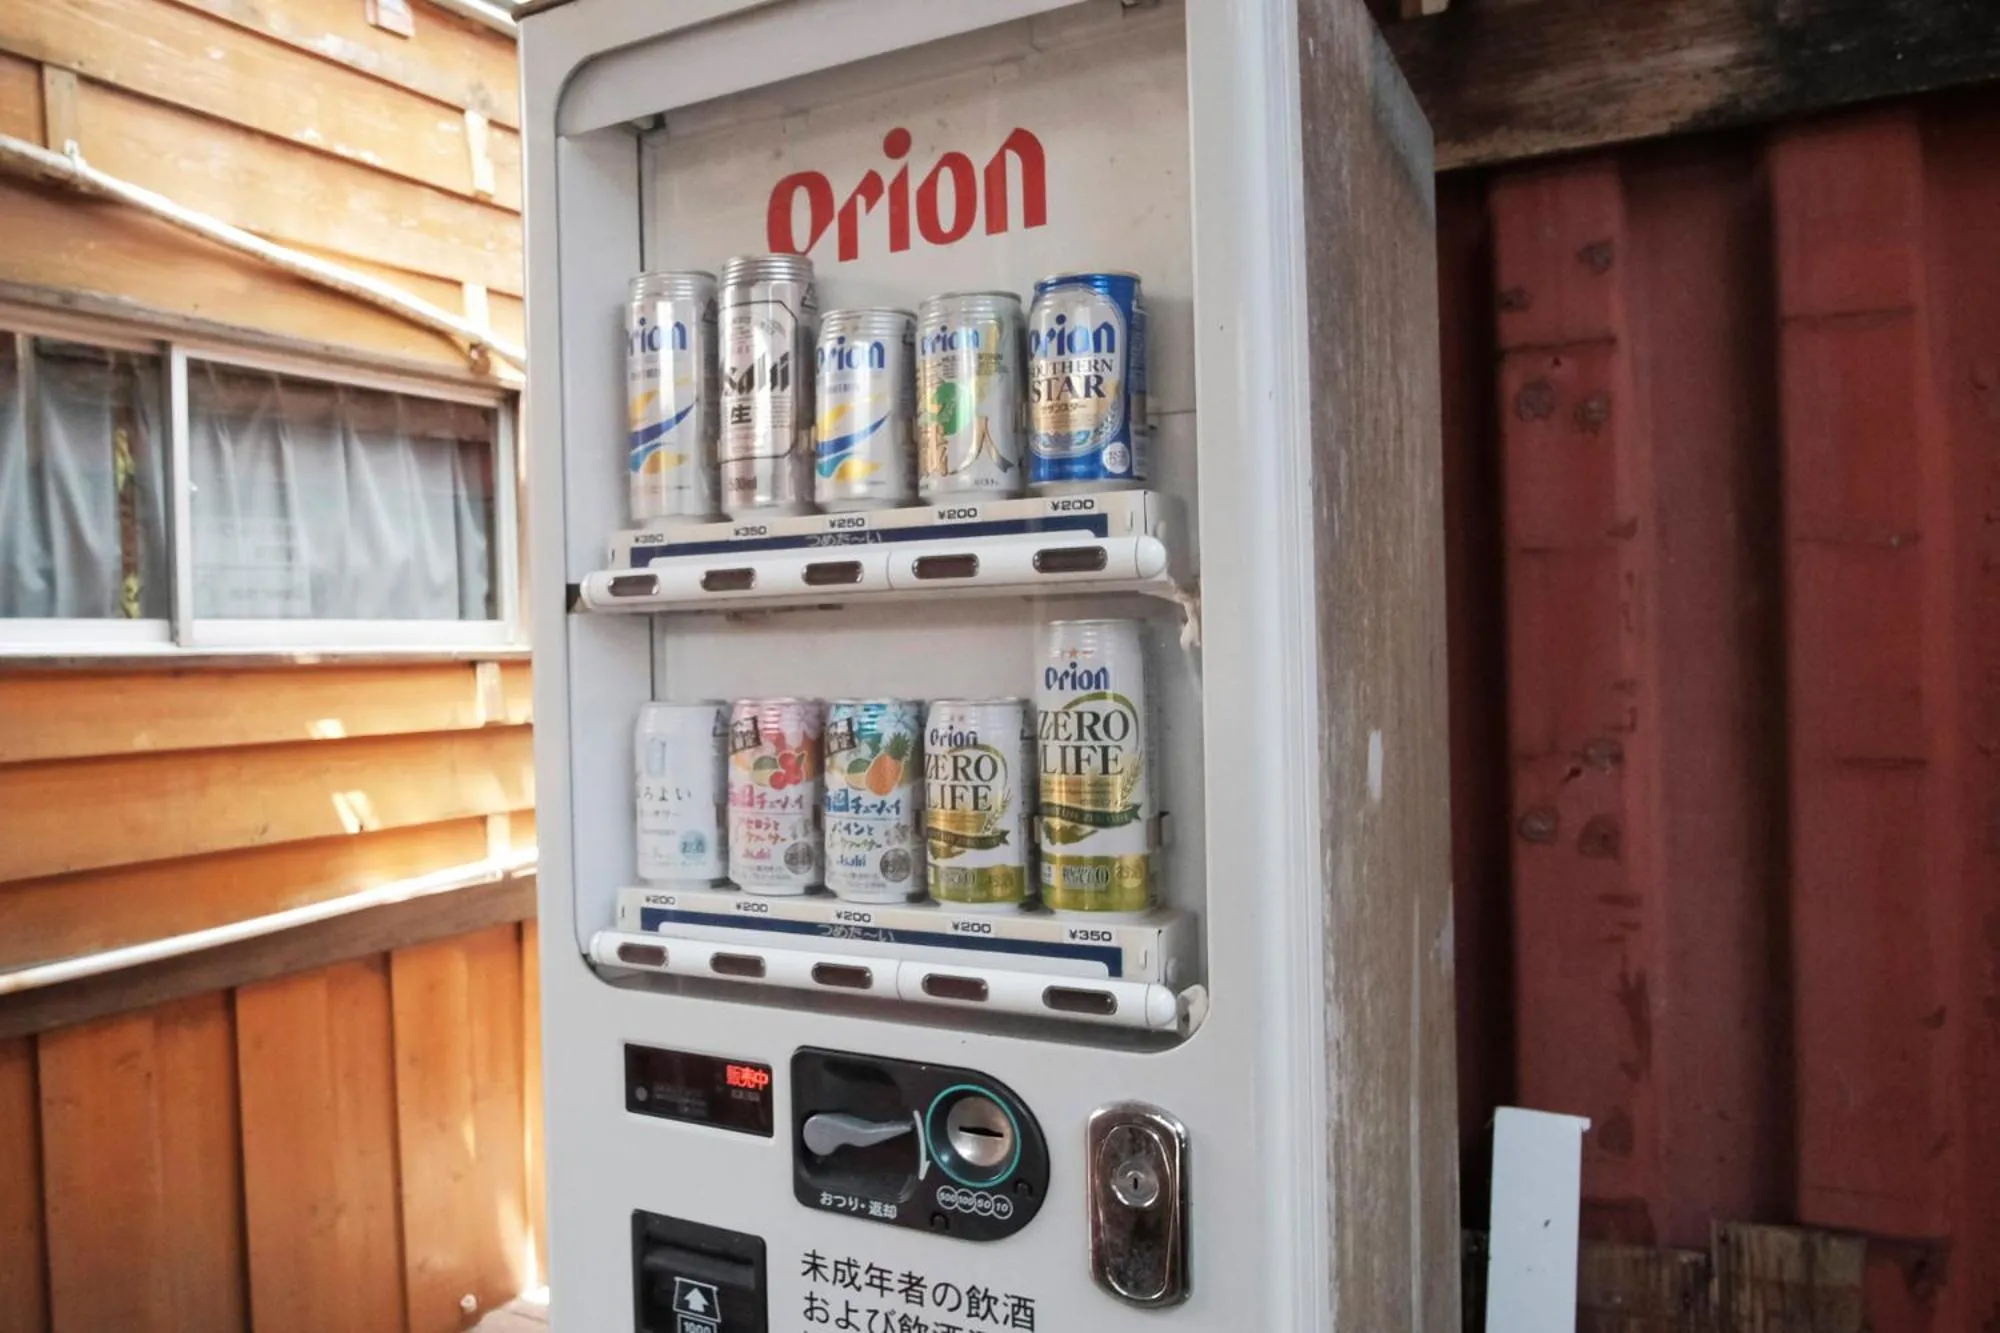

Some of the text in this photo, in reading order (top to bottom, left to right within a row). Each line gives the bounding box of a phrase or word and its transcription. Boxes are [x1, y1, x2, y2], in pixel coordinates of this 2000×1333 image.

[1031, 375, 1106, 403] STAR
[1051, 499, 1094, 511] ¥200
[938, 508, 977, 520] ¥200
[733, 525, 767, 536] ¥350
[1036, 709, 1130, 742] ZERO
[1040, 744, 1124, 775] LIFE
[926, 783, 992, 811] LIFE
[736, 902, 768, 914] ¥200
[836, 911, 871, 923] ¥200
[952, 921, 992, 933] ¥200
[1069, 928, 1112, 942] ¥350
[996, 1203, 1008, 1213] 10
[801, 1249, 1035, 1332] 未成年者の飲酒
